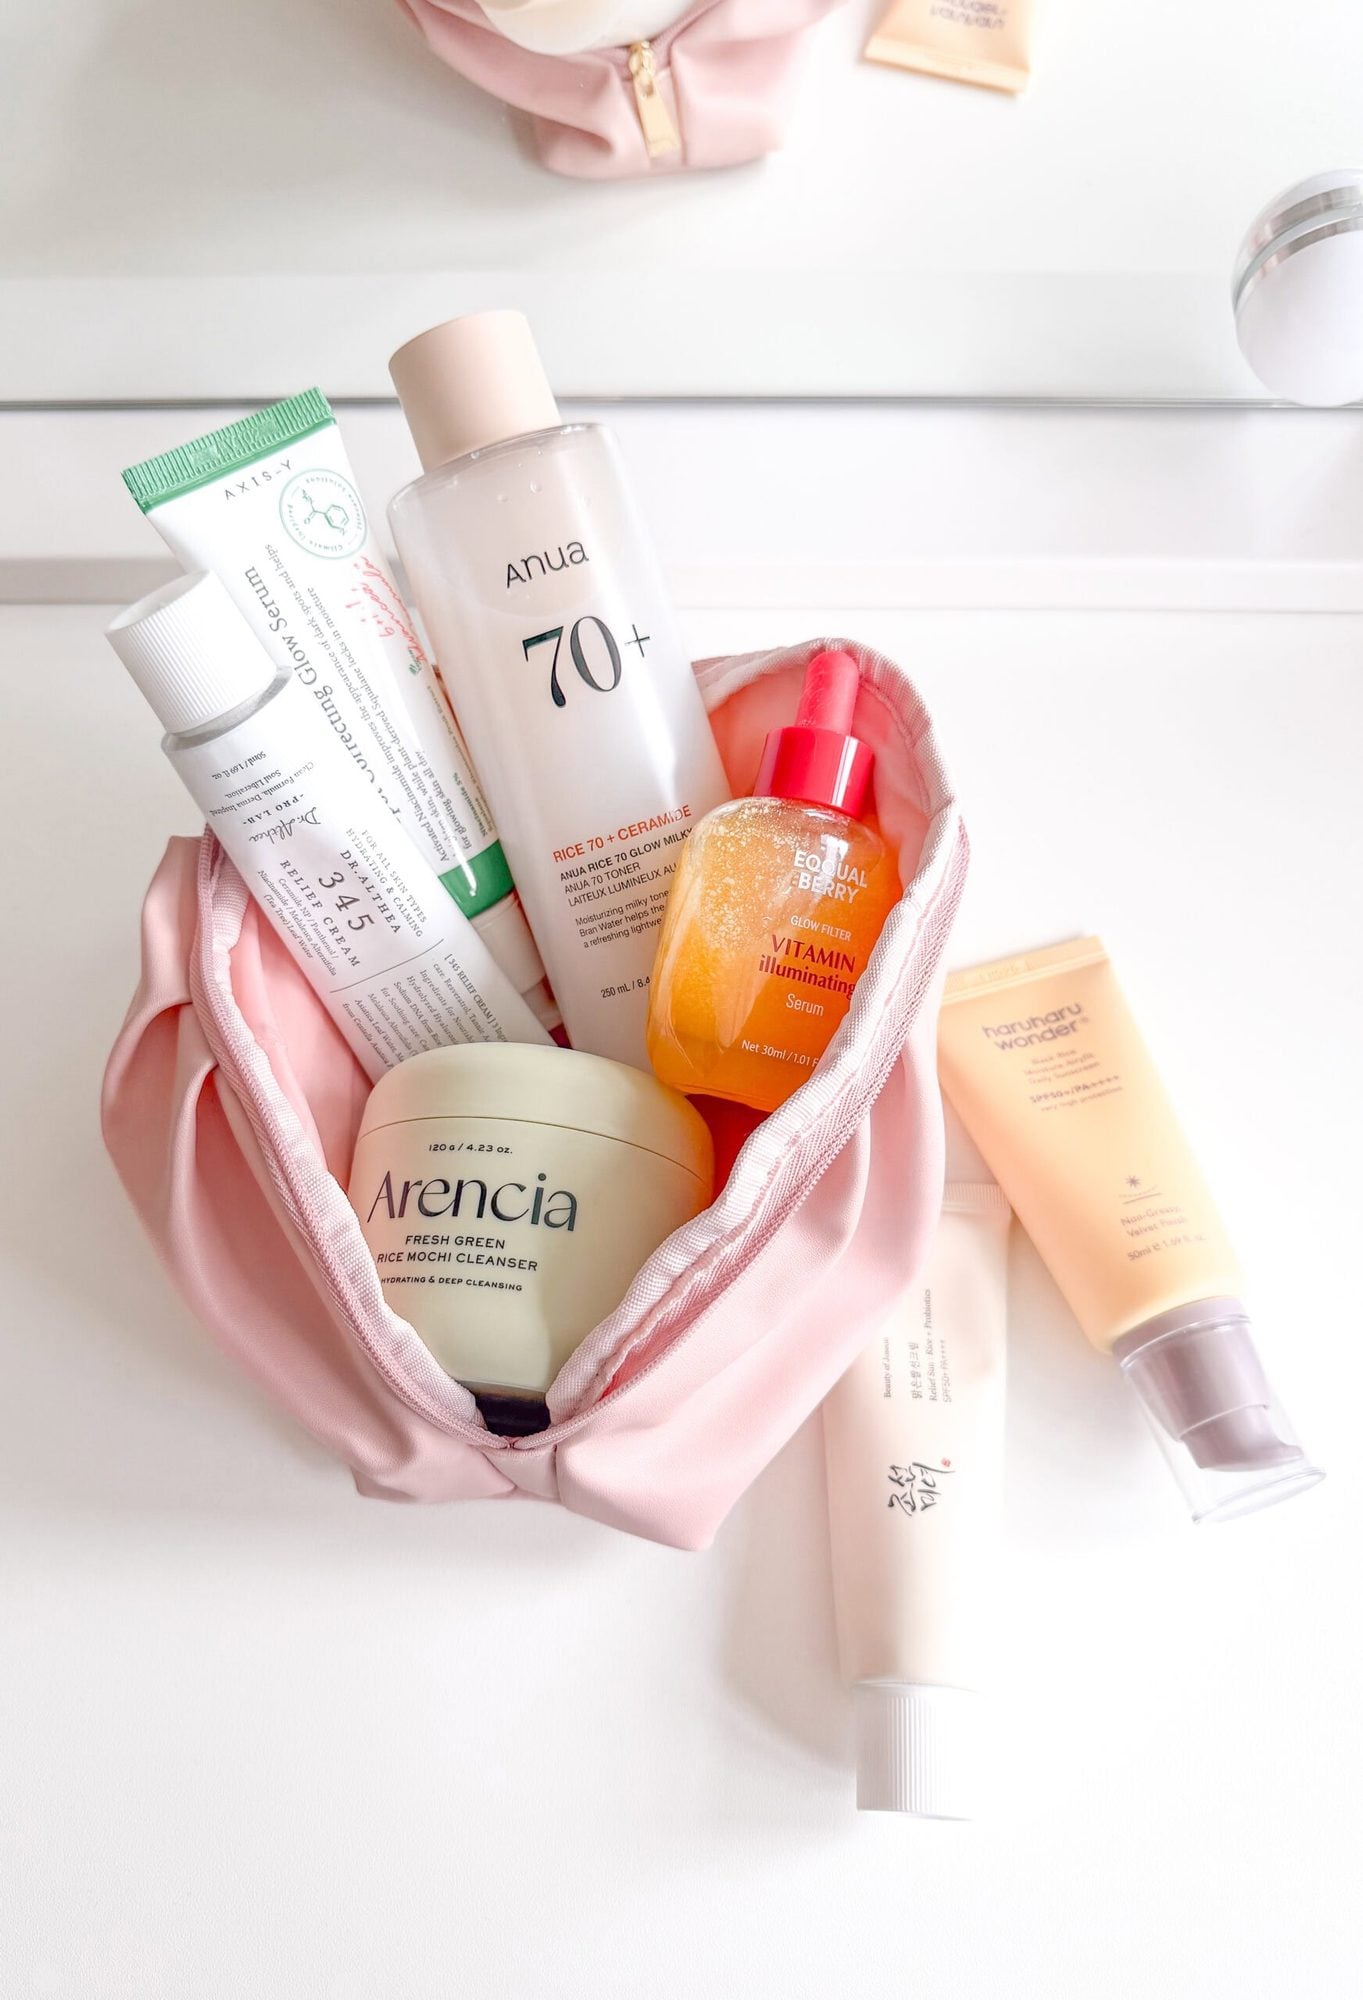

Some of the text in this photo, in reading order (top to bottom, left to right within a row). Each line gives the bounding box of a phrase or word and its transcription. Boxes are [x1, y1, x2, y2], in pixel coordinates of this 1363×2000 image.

[224, 458, 290, 500] AXIS-Y
[238, 564, 288, 634] Serum
[304, 584, 335, 630] moisture
[261, 541, 371, 722] the appearance of dark spots and helps
[277, 630, 320, 688] Glow
[336, 639, 357, 668] locks
[350, 665, 383, 711] Squalane
[364, 718, 398, 765] improves
[262, 768, 282, 784] Soul
[388, 763, 427, 823] Niacinamide
[408, 770, 430, 797] while
[420, 766, 435, 782] all
[427, 780, 445, 801] skin
[235, 791, 262, 810] Derma
[438, 798, 467, 837] glowing
[419, 820, 450, 864] Activated
[459, 835, 473, 850] for
[552, 804, 693, 863] RICE 70 + CERAMIDE
[359, 828, 428, 925] FOR ALL SKIN TYPES
[558, 865, 585, 882] ANUA
[586, 855, 613, 873] RICE
[613, 850, 627, 864] 70
[628, 838, 662, 858] GLOW
[562, 860, 641, 895] ANUA 70 TONER
[257, 869, 290, 908] Niacinamide
[344, 827, 389, 884] HYDRATING
[384, 884, 396, 895] &
[390, 894, 424, 939] CALMING
[567, 886, 607, 908] LAITEUX
[605, 867, 662, 895] LUMINEUX
[797, 870, 859, 904] BERRY
[277, 875, 304, 910] Ceramide
[308, 920, 336, 956] Panthenol
[279, 859, 361, 969] RELIEF CREAM
[575, 903, 625, 929] Moisturizing
[623, 894, 649, 912] milky
[578, 901, 665, 938] Bran Water helps the
[789, 914, 852, 941] GLOW FILTER
[588, 925, 630, 949] refreshing
[772, 933, 855, 972] VITAMIN
[456, 970, 476, 995] RELIEF
[472, 993, 493, 1019] CREAM
[599, 986, 616, 999] 250
[616, 981, 630, 994] mL
[758, 954, 855, 999] illuminating
[785, 992, 824, 1015] Serum
[740, 1039, 759, 1053] Net
[761, 1044, 786, 1059] 30ml
[792, 1053, 810, 1065] 1.01
[429, 1142, 446, 1151] 120
[466, 1143, 493, 1152] 4.23
[496, 1145, 512, 1153] oz.
[366, 1169, 578, 1231] Arencia
[377, 1252, 538, 1271] RICE MOCHI CLEANSER
[404, 1235, 505, 1249] FRESH GREEN
[427, 1275, 435, 1283] &
[438, 1276, 463, 1285] DEEP
[465, 1278, 523, 1291] CLEANSING
